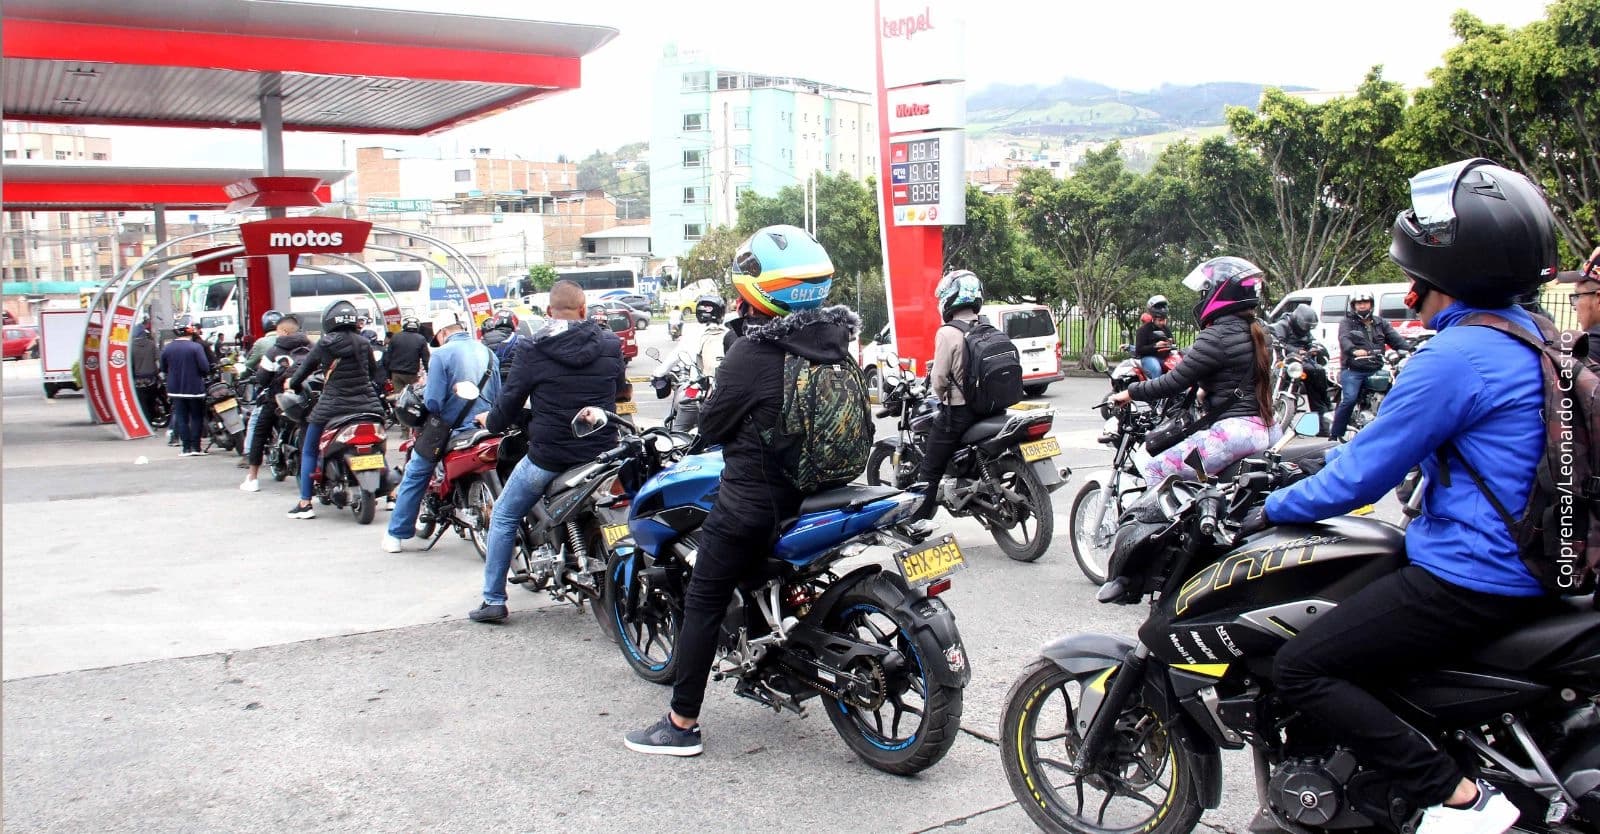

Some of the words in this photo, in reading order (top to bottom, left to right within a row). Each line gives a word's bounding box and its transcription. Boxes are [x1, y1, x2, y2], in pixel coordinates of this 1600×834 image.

[883, 5, 935, 40] terpel
[896, 103, 930, 118] Motos
[270, 229, 343, 247] motos
[1169, 633, 1189, 657] Mobil
